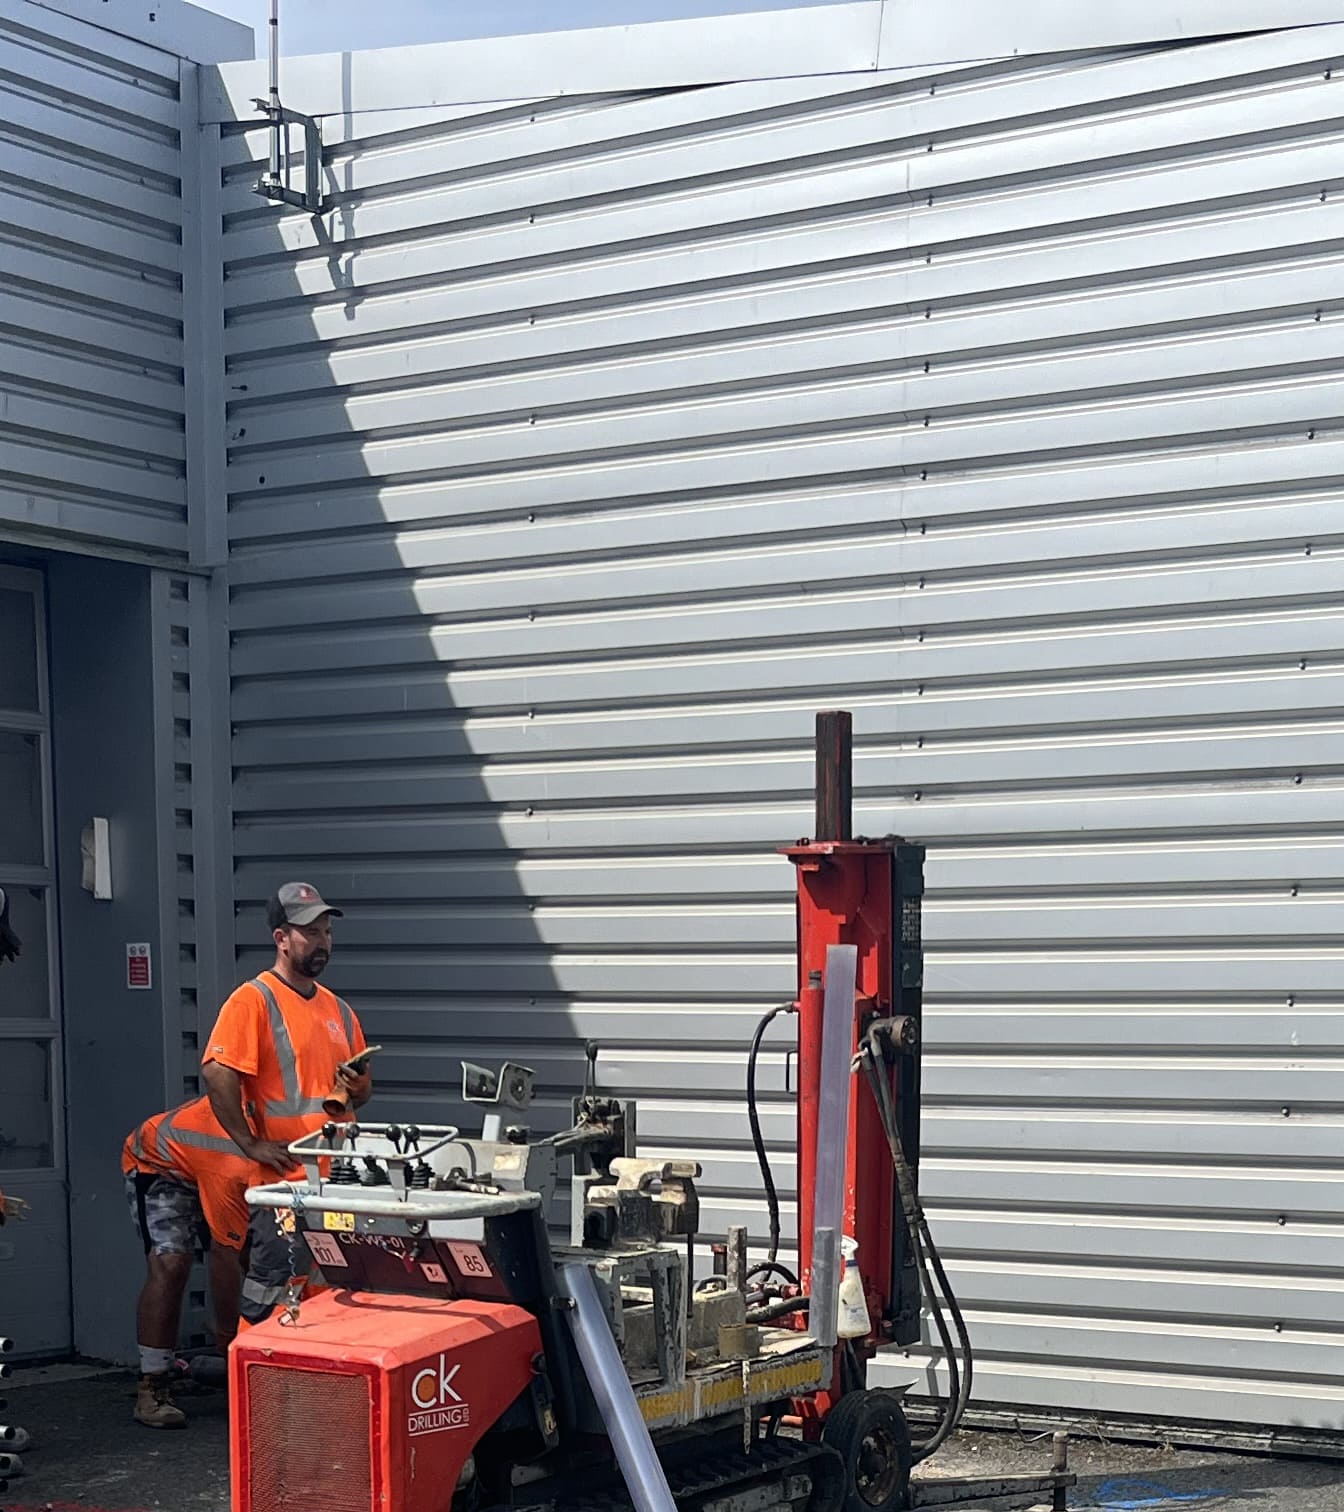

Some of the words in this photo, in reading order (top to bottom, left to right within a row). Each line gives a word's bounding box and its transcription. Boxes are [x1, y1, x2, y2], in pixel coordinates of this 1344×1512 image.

[314, 1247, 337, 1264] 101
[463, 1254, 484, 1272] 85
[408, 1408, 462, 1432] DRILLING
